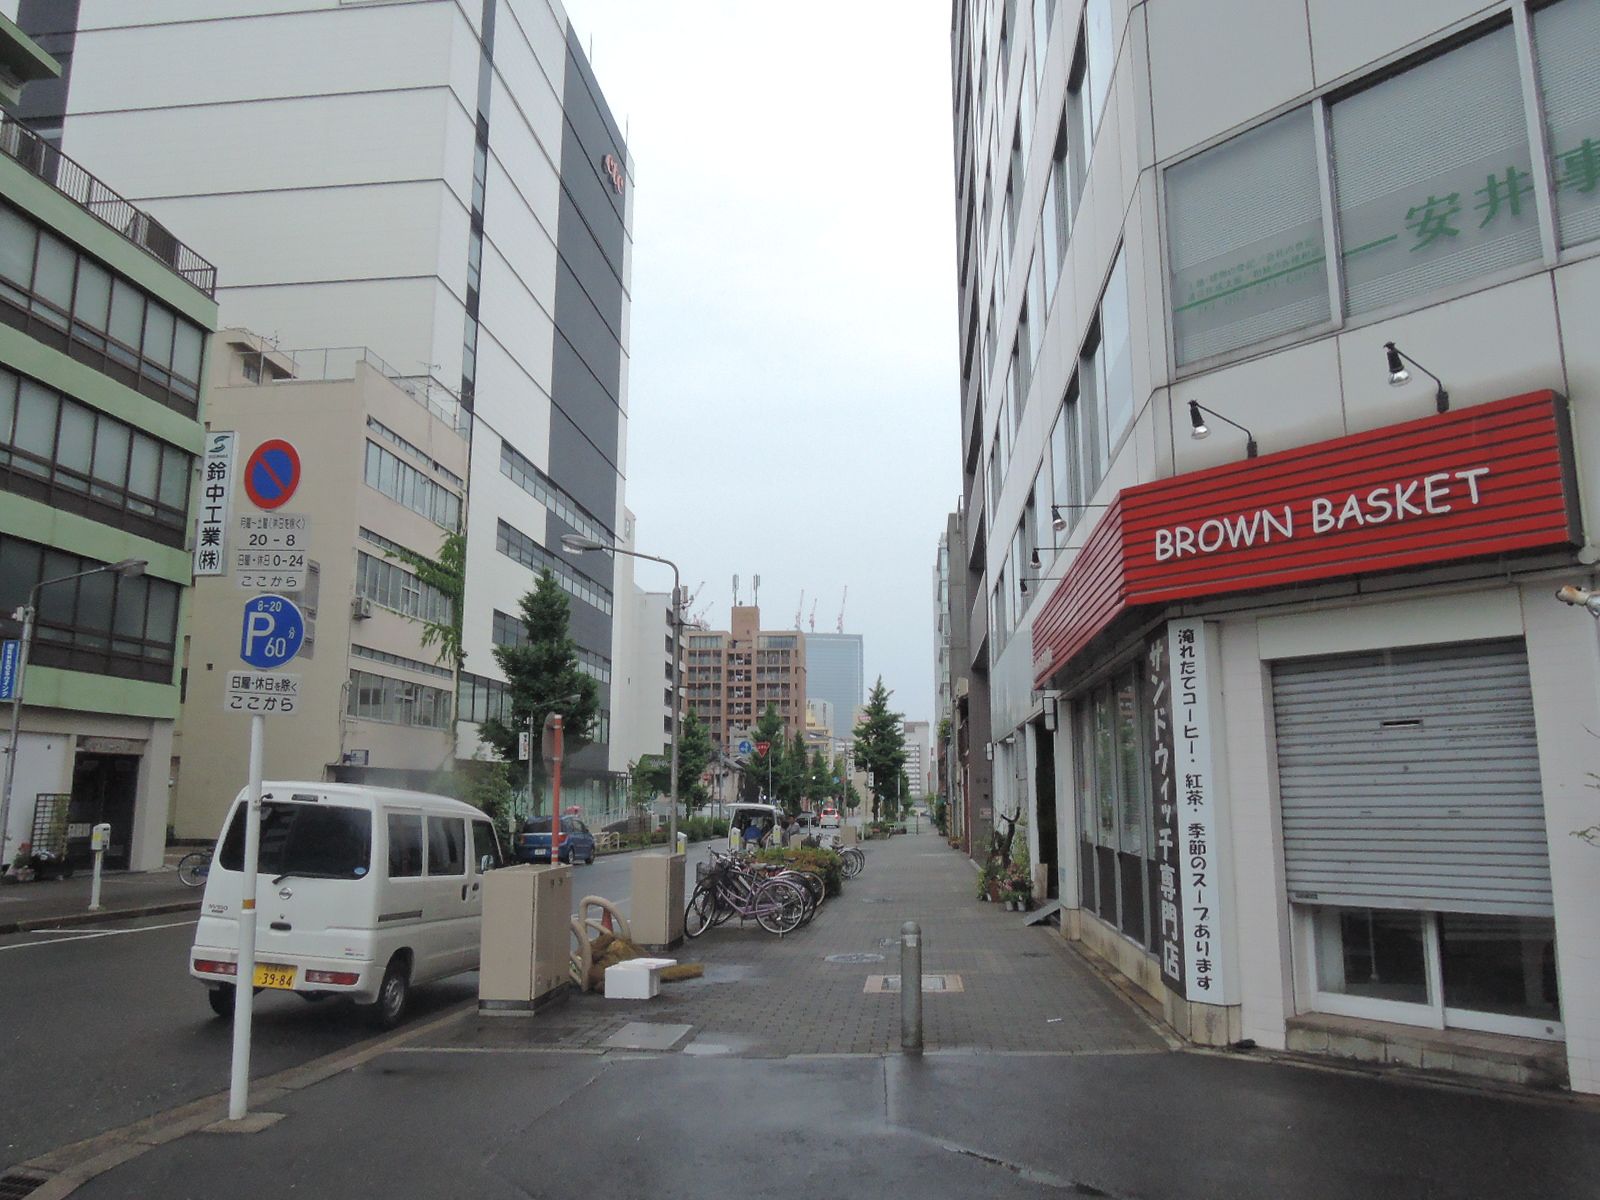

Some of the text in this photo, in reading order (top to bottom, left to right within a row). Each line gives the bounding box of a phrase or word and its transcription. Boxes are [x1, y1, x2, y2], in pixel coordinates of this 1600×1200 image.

[1155, 467, 1490, 561] BROWN BASKET
[273, 554, 304, 567] 0-24
[240, 576, 297, 588] ここから
[257, 600, 283, 612] 8-20
[245, 611, 276, 657] P
[230, 695, 293, 711] ここから
[261, 972, 293, 987] 39-84
